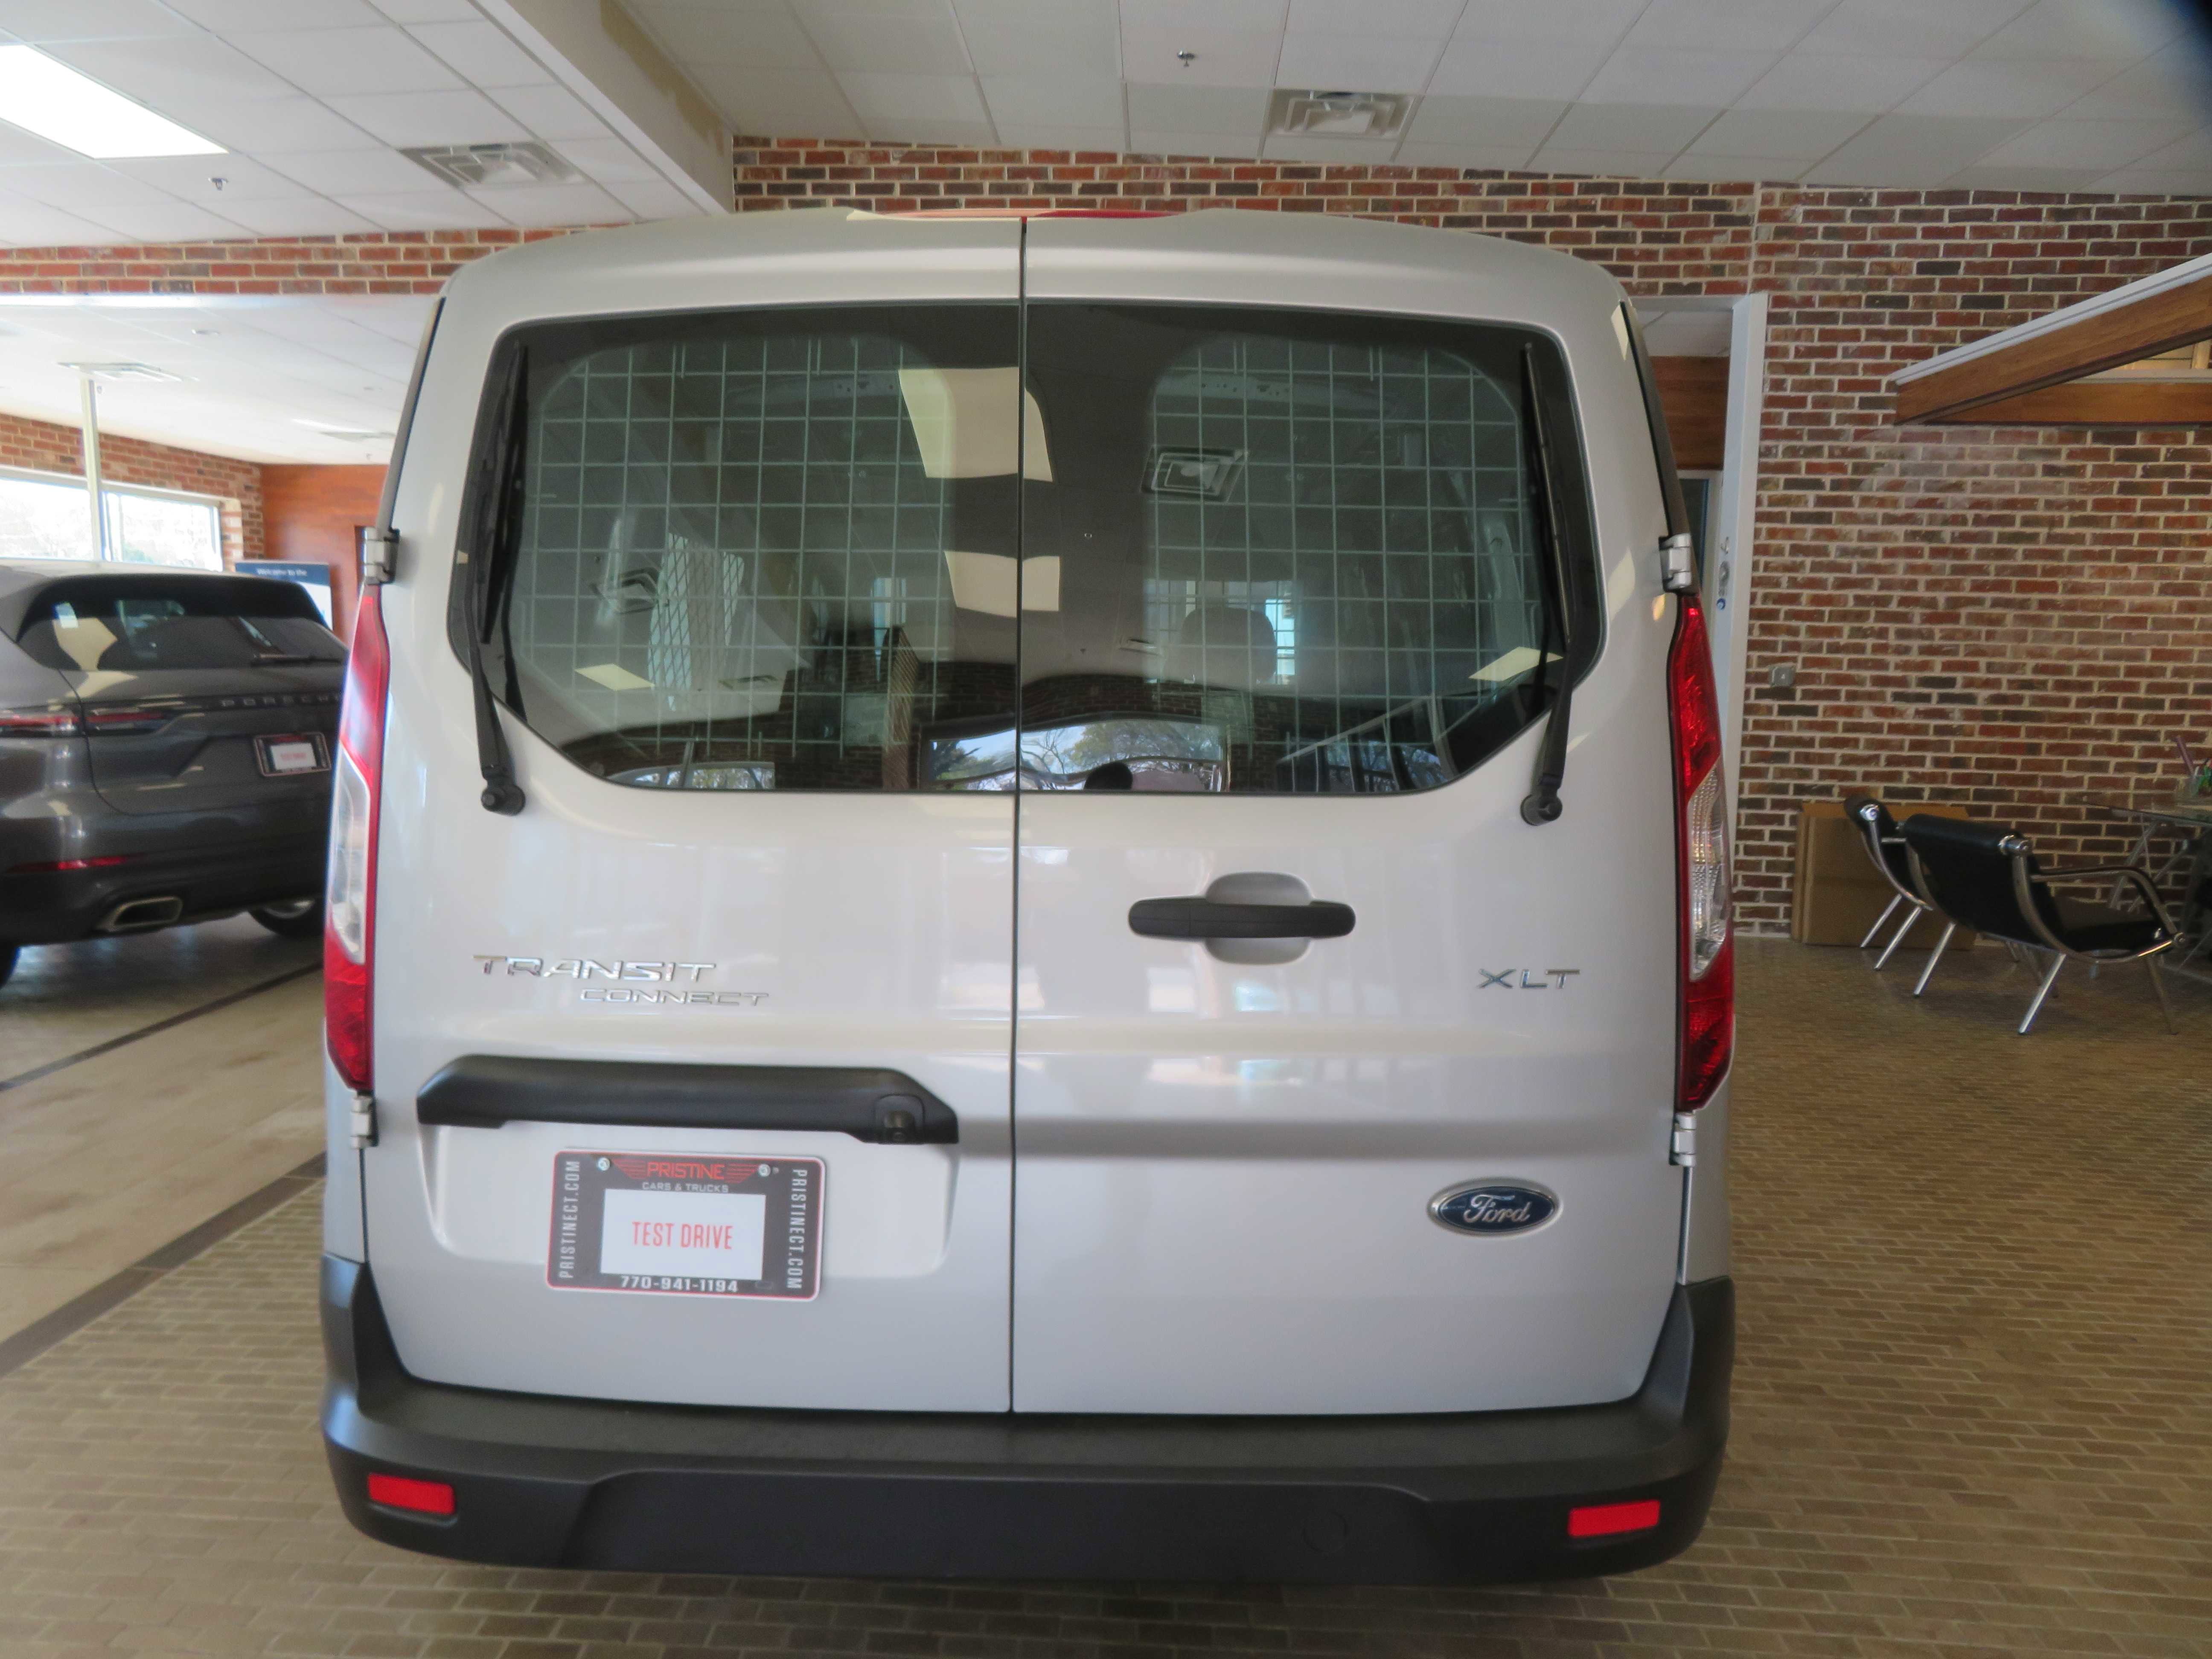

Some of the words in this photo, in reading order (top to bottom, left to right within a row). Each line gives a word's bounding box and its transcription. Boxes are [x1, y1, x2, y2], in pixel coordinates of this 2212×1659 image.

[472, 955, 717, 982] TRANSIT
[1477, 968, 1581, 989] XLT
[580, 988, 770, 1006] CONNECT
[647, 1161, 725, 1180] PRISTINE
[642, 1182, 671, 1190] CARS
[675, 1182, 682, 1191] &
[686, 1183, 729, 1193] TRUCKS
[559, 1161, 580, 1279] PRISTINECT.COM
[1463, 1194, 1533, 1223] Ford
[632, 1221, 675, 1247] TEST
[680, 1223, 733, 1249] DRIVE
[787, 1169, 808, 1289] PRISTINECT.COM
[620, 1275, 738, 1293] 770-941-1194
